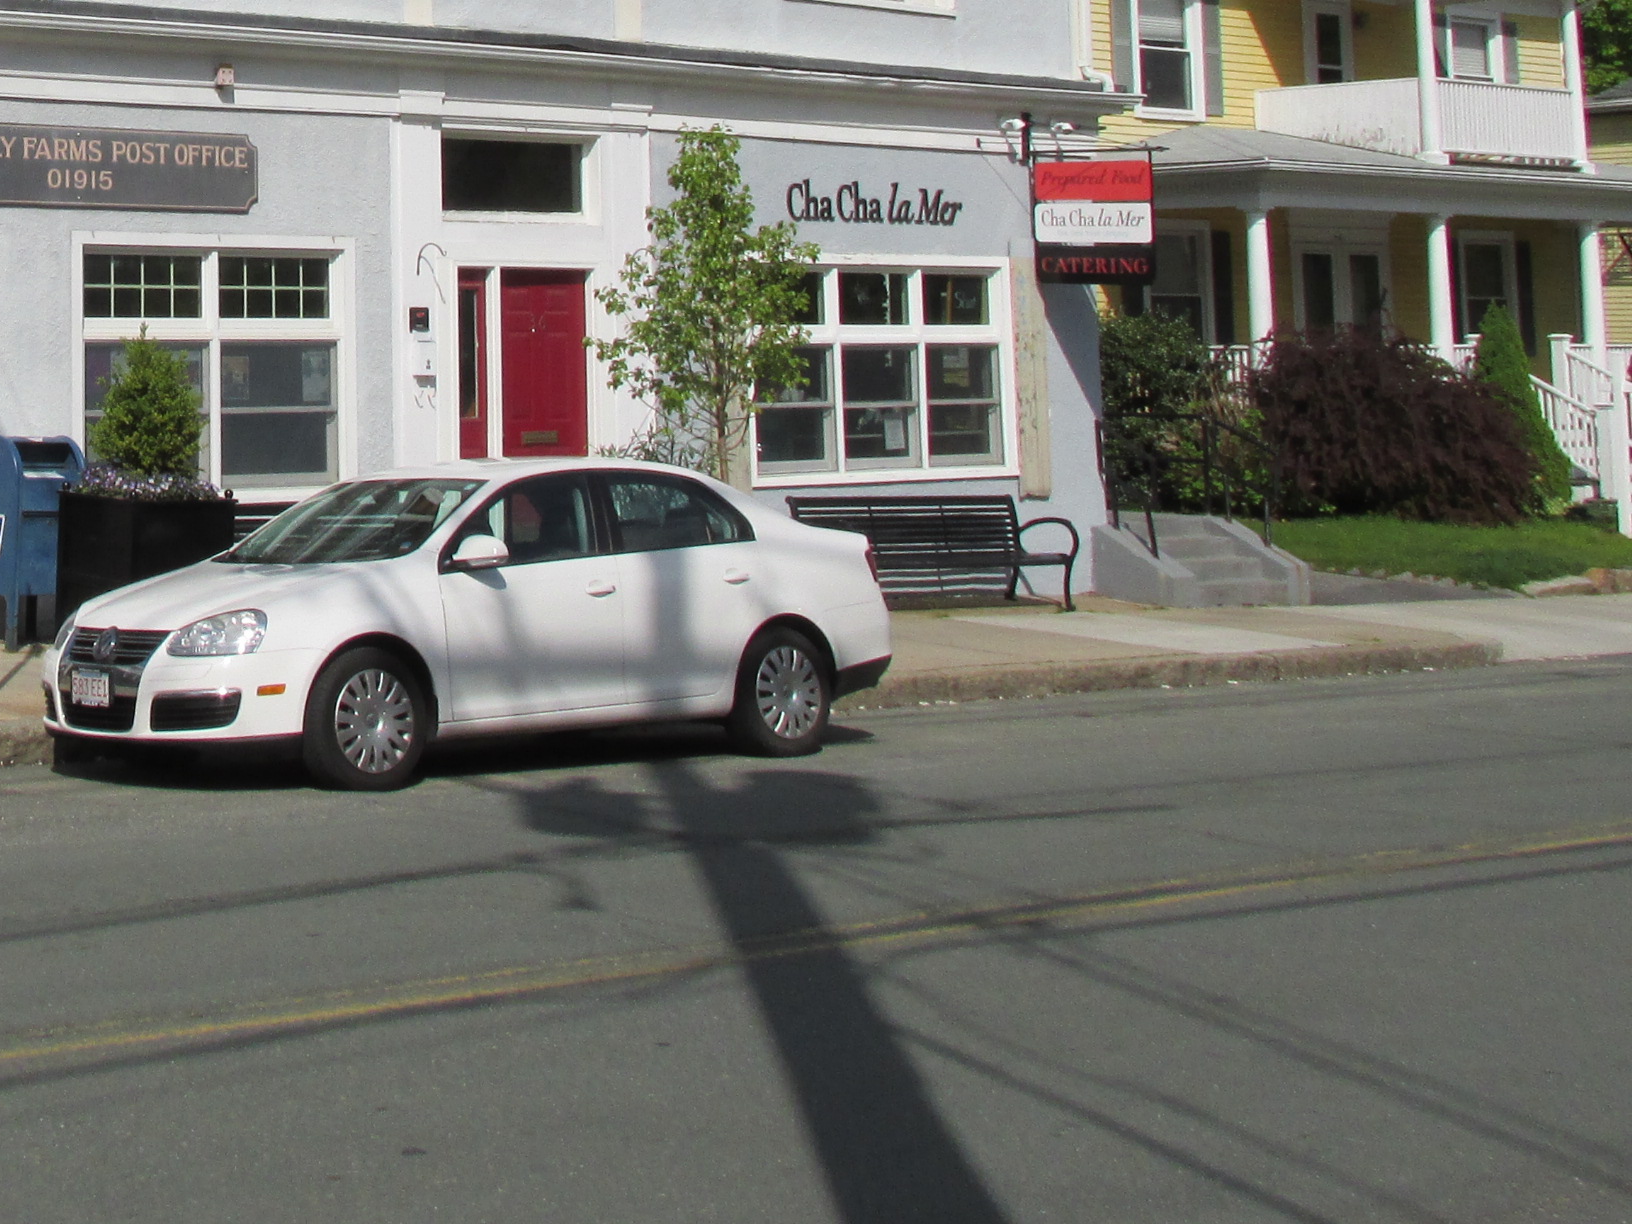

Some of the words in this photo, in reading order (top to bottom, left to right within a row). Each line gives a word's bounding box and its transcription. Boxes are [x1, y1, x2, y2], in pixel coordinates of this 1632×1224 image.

[22, 137, 103, 162] FARMS
[111, 140, 170, 165] POST
[174, 144, 248, 168] OFFICE
[47, 168, 113, 191] 01915
[1041, 168, 1108, 193] Prepared
[1111, 167, 1146, 185] Food
[786, 178, 835, 222] Cha
[836, 180, 883, 224] Cha
[887, 182, 915, 225] la
[914, 187, 963, 226] Mer
[1041, 208, 1066, 227] Cha
[1068, 208, 1095, 227] Cha
[1097, 208, 1112, 227] la
[1115, 209, 1145, 227] Mer
[1041, 256, 1149, 274] CATERING
